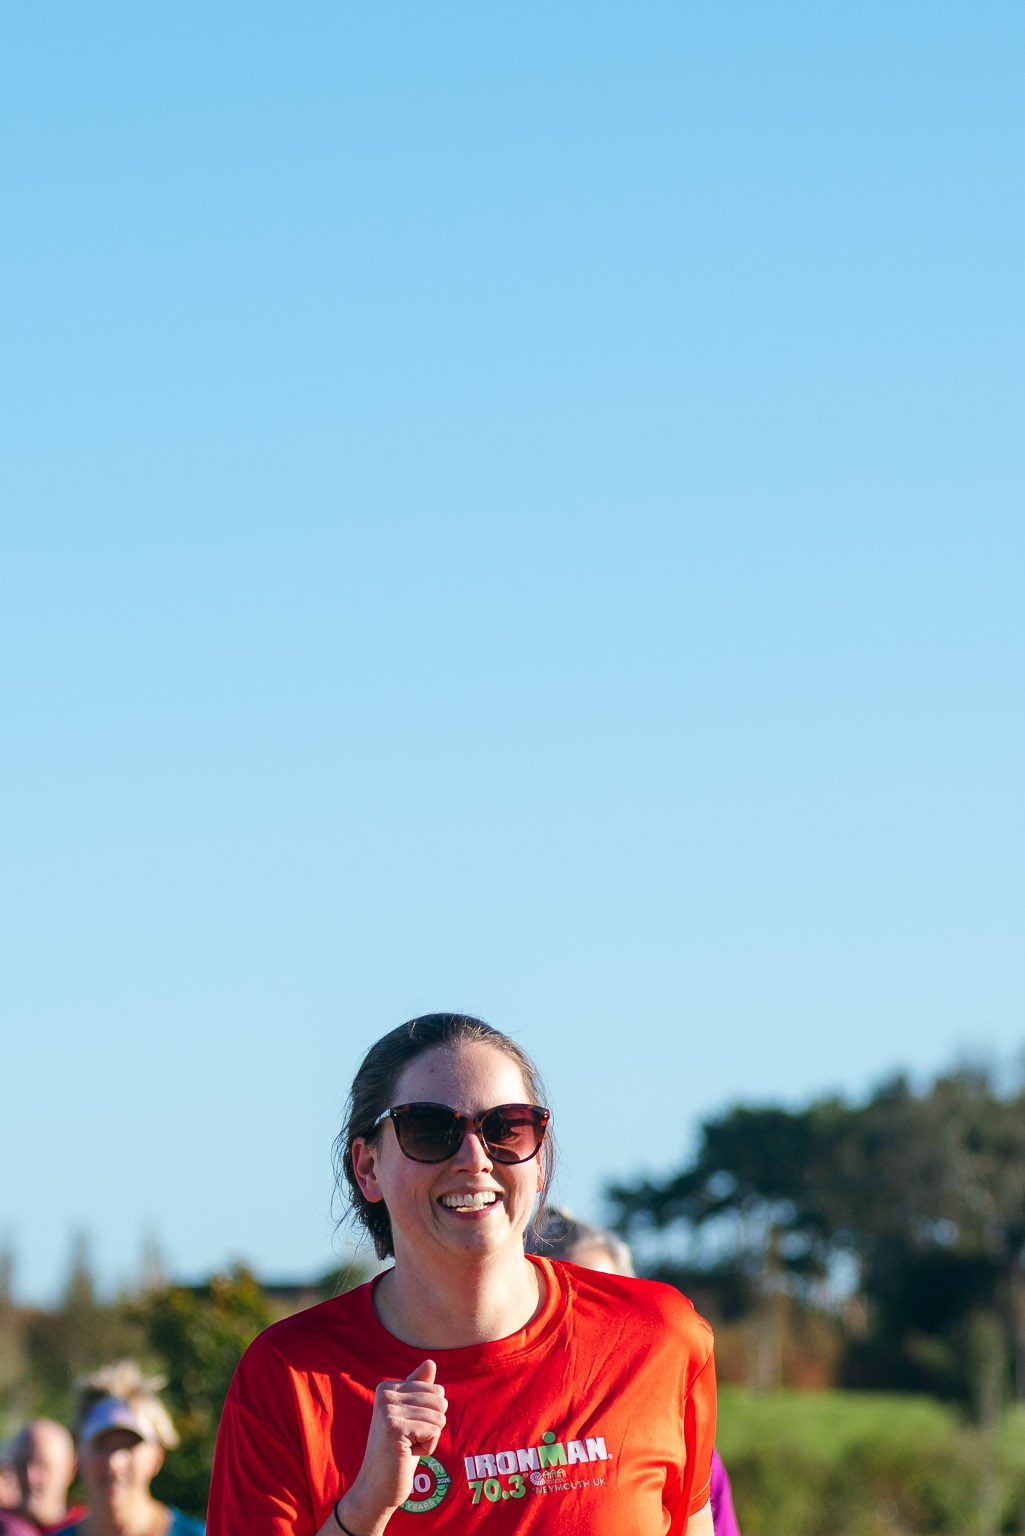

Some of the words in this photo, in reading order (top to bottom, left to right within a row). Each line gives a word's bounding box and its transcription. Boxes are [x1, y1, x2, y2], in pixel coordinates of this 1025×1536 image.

[464, 1432, 608, 1480] IRONMAN
[412, 1474, 431, 1493] 0
[468, 1475, 526, 1504] 70.3
[532, 1480, 590, 1495] WEYMOUTH
[593, 1478, 606, 1487] UK
[407, 1499, 435, 1511] YEARS
